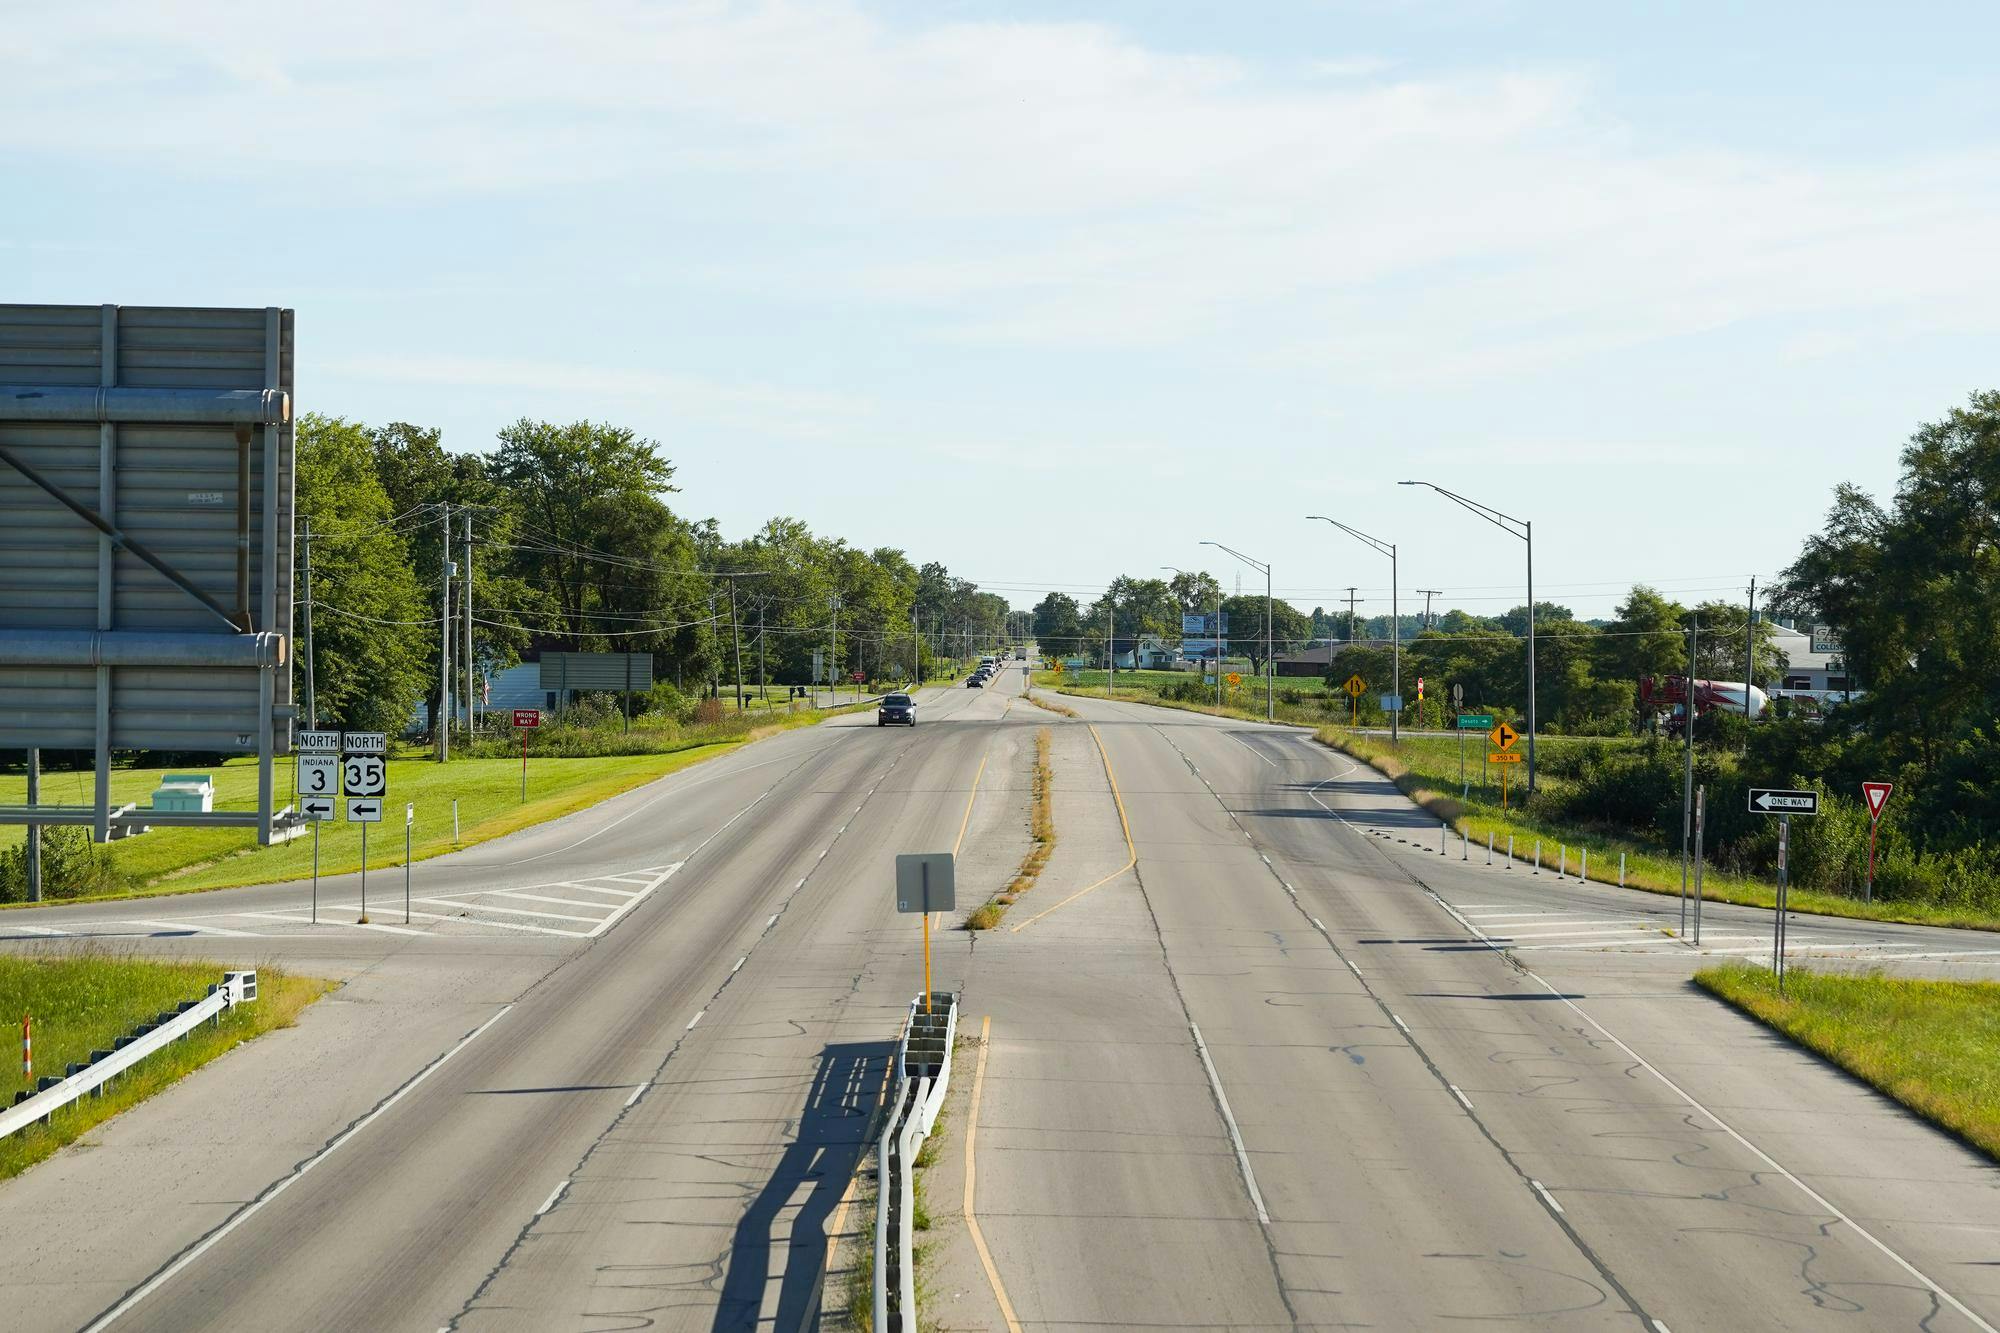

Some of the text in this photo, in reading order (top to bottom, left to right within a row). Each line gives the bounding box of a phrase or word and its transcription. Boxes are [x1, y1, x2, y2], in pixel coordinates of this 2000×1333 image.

[301, 735, 338, 747] NORTH
[346, 736, 383, 748] NORTH
[311, 769, 326, 791] 3
[347, 764, 381, 787] 35
[1771, 797, 1807, 807] ONE WAY
